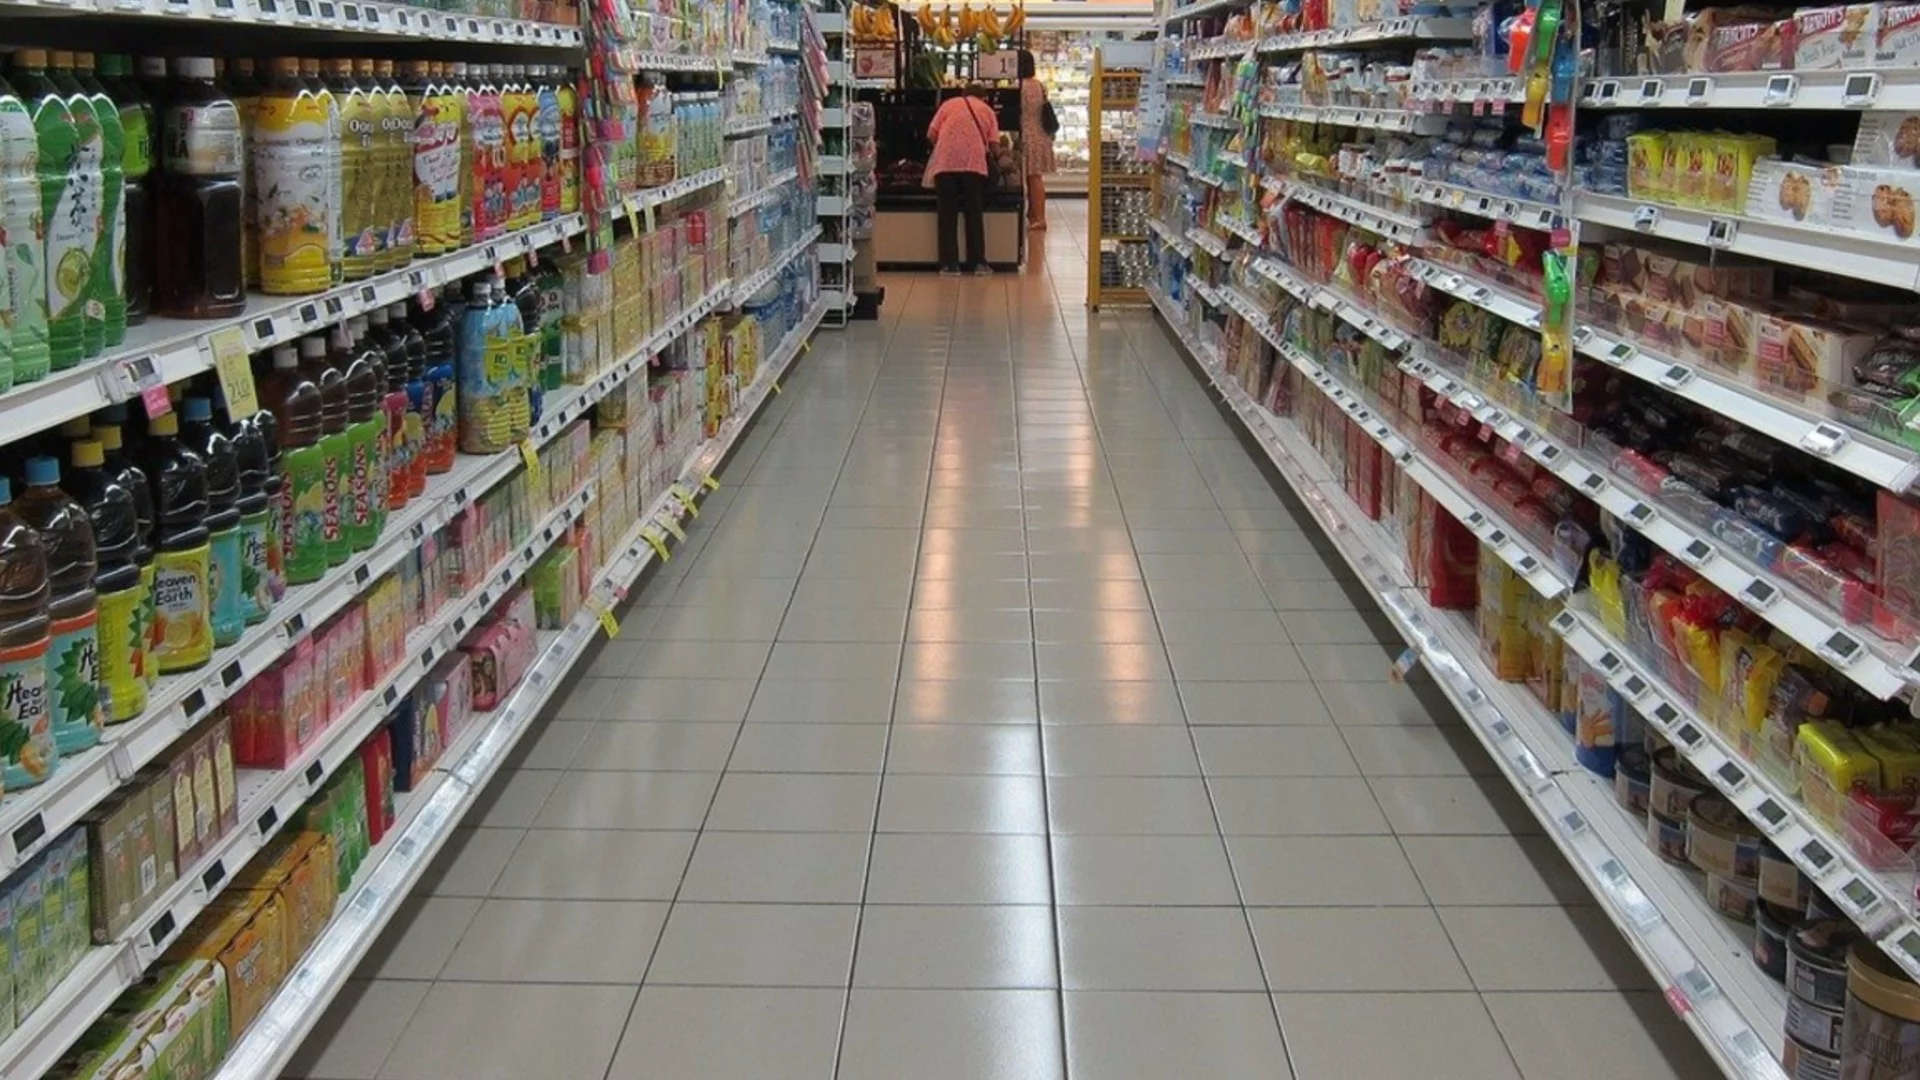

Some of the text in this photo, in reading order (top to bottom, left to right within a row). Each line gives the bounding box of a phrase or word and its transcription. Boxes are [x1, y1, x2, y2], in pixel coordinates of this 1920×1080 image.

[325, 455, 339, 541] SEASONS
[354, 442, 368, 526] SEASONS
[155, 585, 193, 607] Earth
